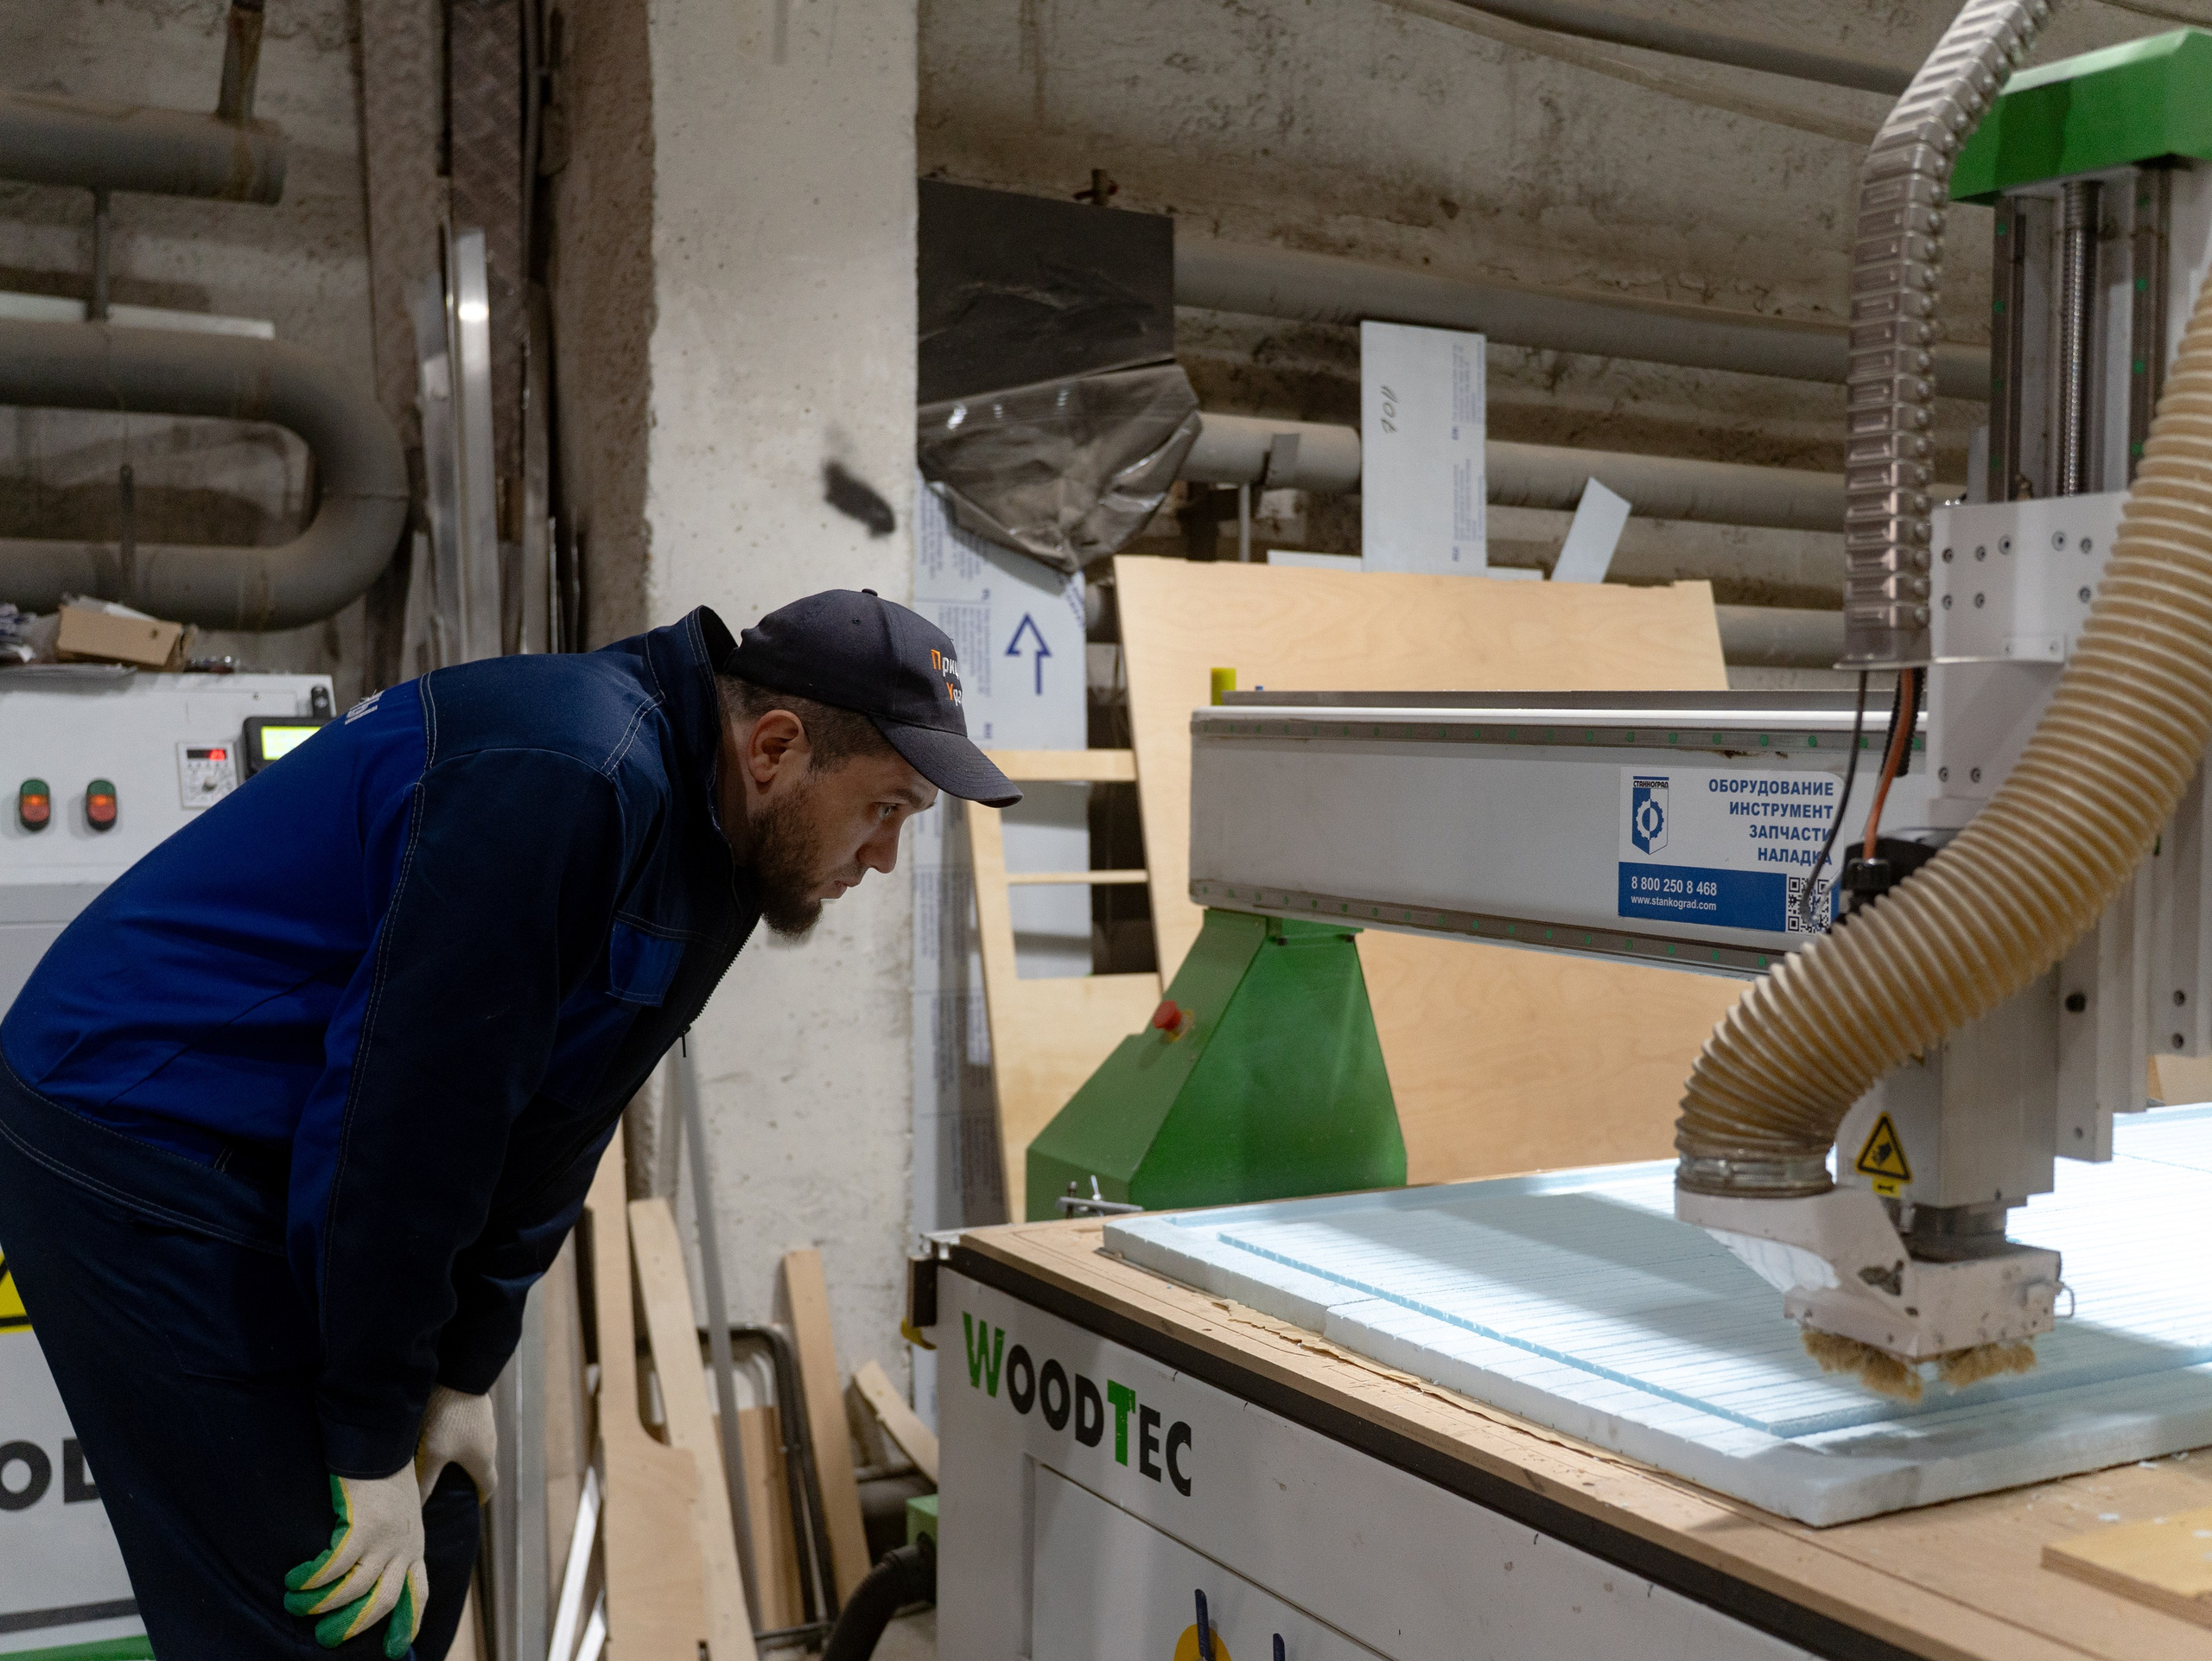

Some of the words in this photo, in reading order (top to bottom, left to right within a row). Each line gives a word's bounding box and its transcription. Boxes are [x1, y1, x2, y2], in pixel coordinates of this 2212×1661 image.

[1709, 779, 1834, 796] ОБОРУДОВАНИЕ
[1730, 802, 1833, 818] ИНСТРУМЕНТ
[1750, 824, 1832, 842] ЗАПЧАСТИ
[1758, 848, 1832, 866] НАЛАДКА
[1631, 876, 1637, 888] 8
[1641, 877, 1660, 891] 800
[1663, 879, 1682, 894] 250
[1687, 881, 1693, 894] 8
[1697, 881, 1717, 896] 468
[1631, 895, 1716, 911] www.stankograd.com
[962, 1311, 1192, 1497] WOODTEC
